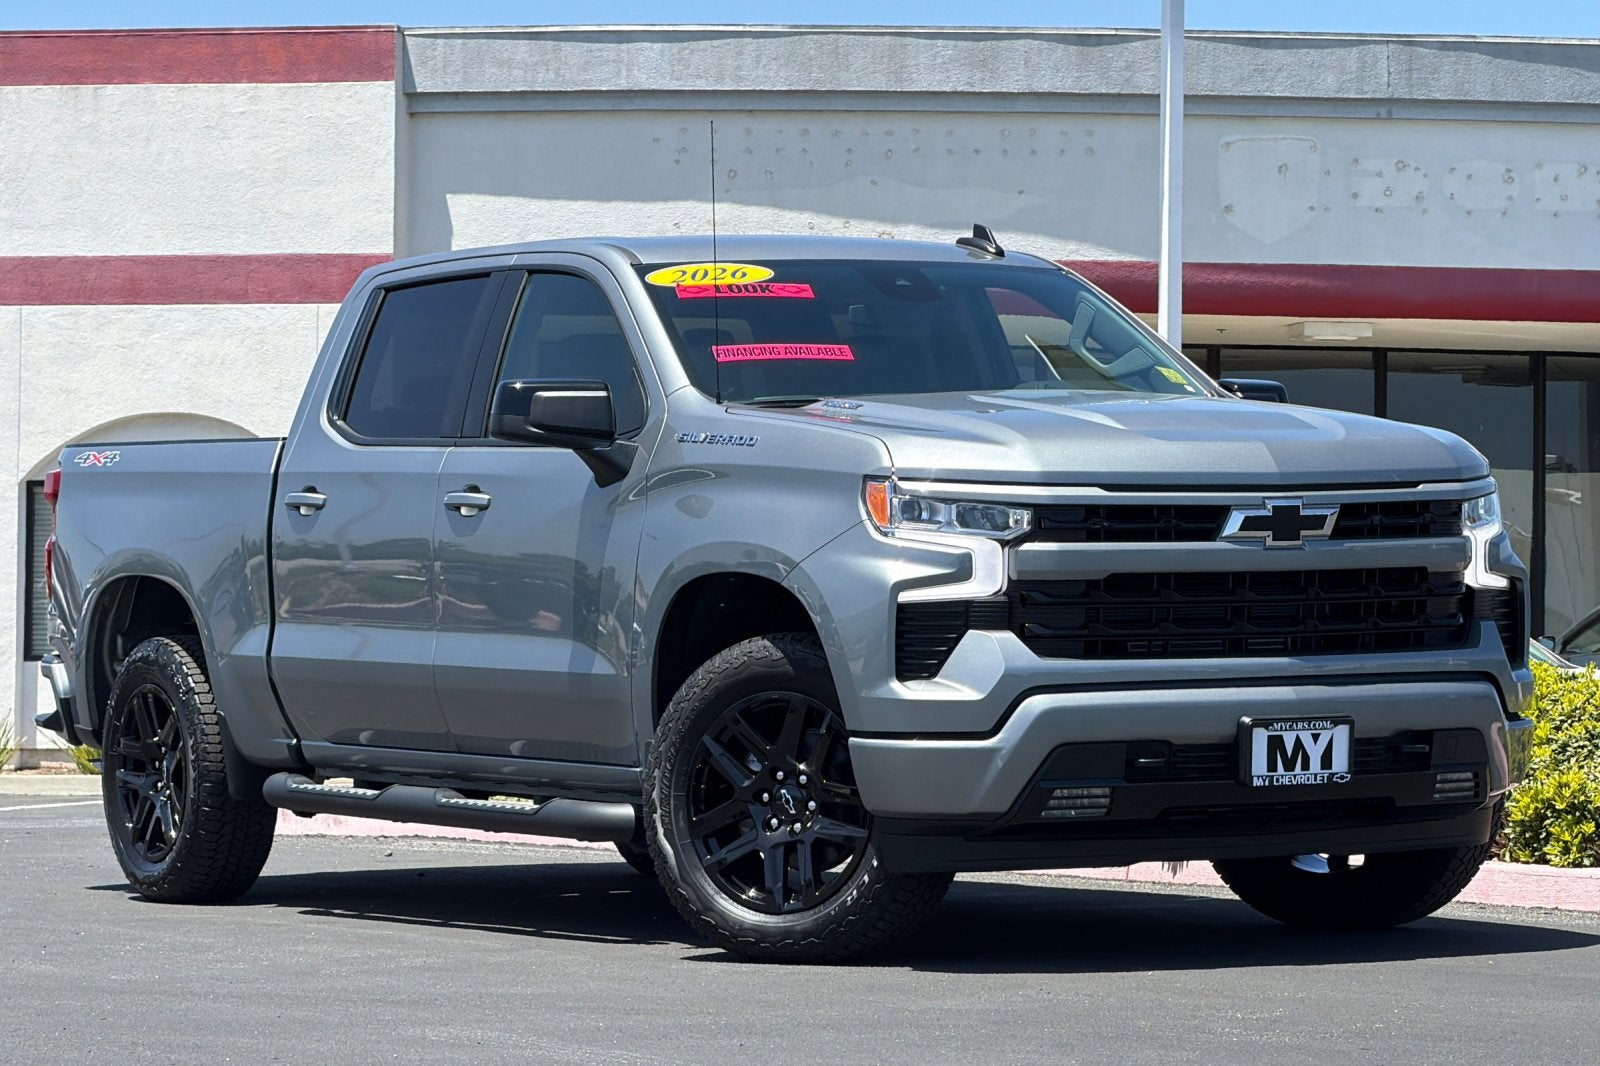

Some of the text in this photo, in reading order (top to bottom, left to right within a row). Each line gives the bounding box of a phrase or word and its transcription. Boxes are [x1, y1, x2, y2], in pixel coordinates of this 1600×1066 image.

[671, 266, 748, 283] 2026
[715, 284, 775, 295] LOOK
[716, 346, 848, 359] FINANCING AVAILABLE
[677, 432, 759, 447] SILVERADO
[1272, 720, 1331, 731] MYCARS.COM
[1267, 731, 1334, 773] MY
[1253, 774, 1330, 787] MY CHEVROLET
